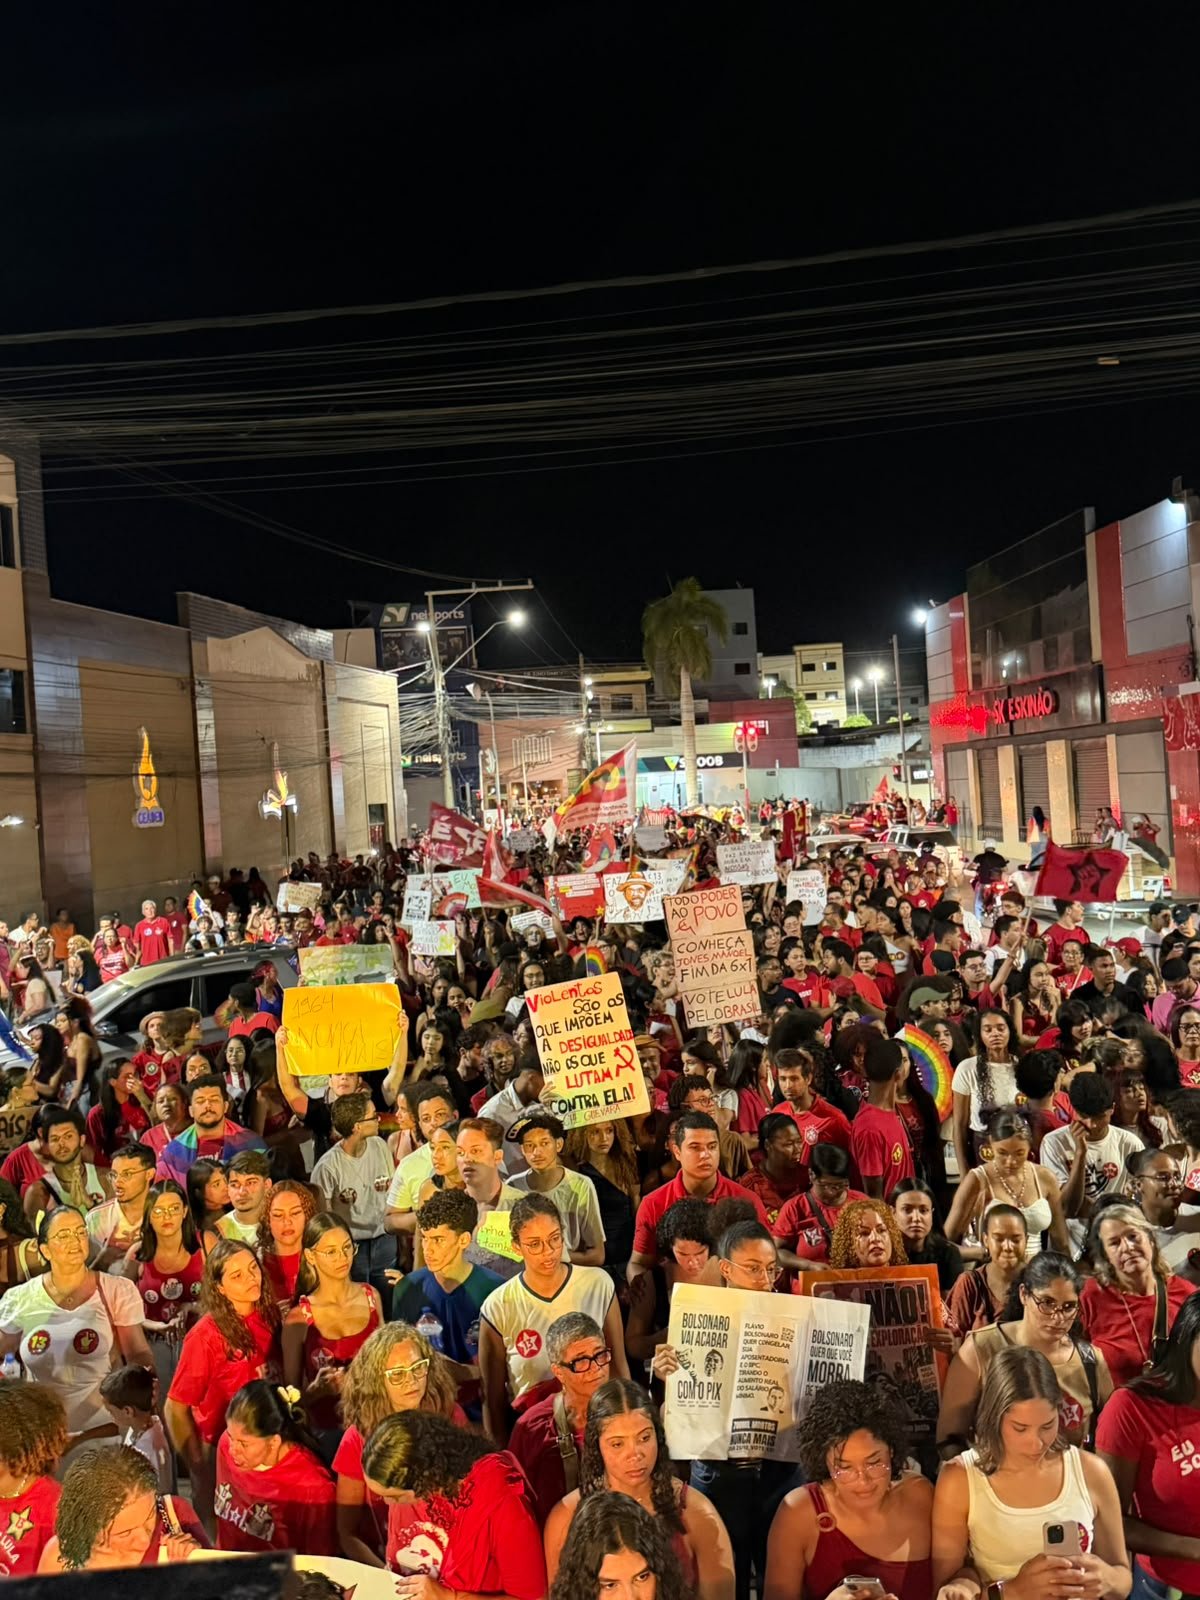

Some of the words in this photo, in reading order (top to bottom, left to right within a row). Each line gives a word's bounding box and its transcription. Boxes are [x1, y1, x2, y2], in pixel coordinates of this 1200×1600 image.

[411, 609, 464, 622] neiports
[679, 756, 724, 769] SOOB
[666, 894, 699, 906] TODO
[701, 887, 737, 904] PODER
[672, 907, 688, 920] AO
[693, 903, 738, 926] POVO
[677, 936, 746, 954] CONHEÇA
[676, 954, 710, 968] JONES
[710, 949, 752, 963] MANOEL
[680, 967, 710, 982] FIM
[712, 962, 728, 976] DA
[730, 958, 752, 973] 6x1
[293, 992, 334, 1018] 1964
[684, 990, 724, 1006] VOTE
[726, 984, 758, 999] LULA
[536, 1022, 562, 1038] QUE
[564, 1010, 614, 1032] IMPÕEM
[687, 1008, 724, 1026] PELO
[724, 1002, 762, 1019] BRASIL
[298, 1018, 367, 1050] NUNCA
[542, 1038, 552, 1052] A
[542, 1058, 560, 1076] NÃO
[566, 1055, 578, 1070] OS
[580, 1052, 606, 1066] QUE
[566, 1067, 614, 1089] LUTAM
[550, 1093, 600, 1114] CONTRA
[603, 1082, 636, 1106] ELA!
[584, 1104, 621, 1120] GUEVARA
[864, 1282, 928, 1326] NÃO!
[682, 1312, 730, 1332] BOLSONARO
[681, 1330, 694, 1345] VAI
[695, 1332, 728, 1348] ACABAR
[744, 1330, 779, 1340] BOLSONARO
[758, 1340, 790, 1350] CONGELAR
[811, 1329, 854, 1348] BOLSONARO
[810, 1346, 826, 1358] QUER
[826, 1347, 838, 1360] QUE
[838, 1348, 852, 1362] VOCÊ
[808, 1359, 850, 1385] MORRA
[678, 1380, 696, 1400] COM
[698, 1382, 704, 1400] O
[706, 1382, 722, 1400] PIX
[730, 1432, 751, 1446] NUNCA
[752, 1432, 776, 1447] MAIS
[1171, 1440, 1195, 1463] EU
